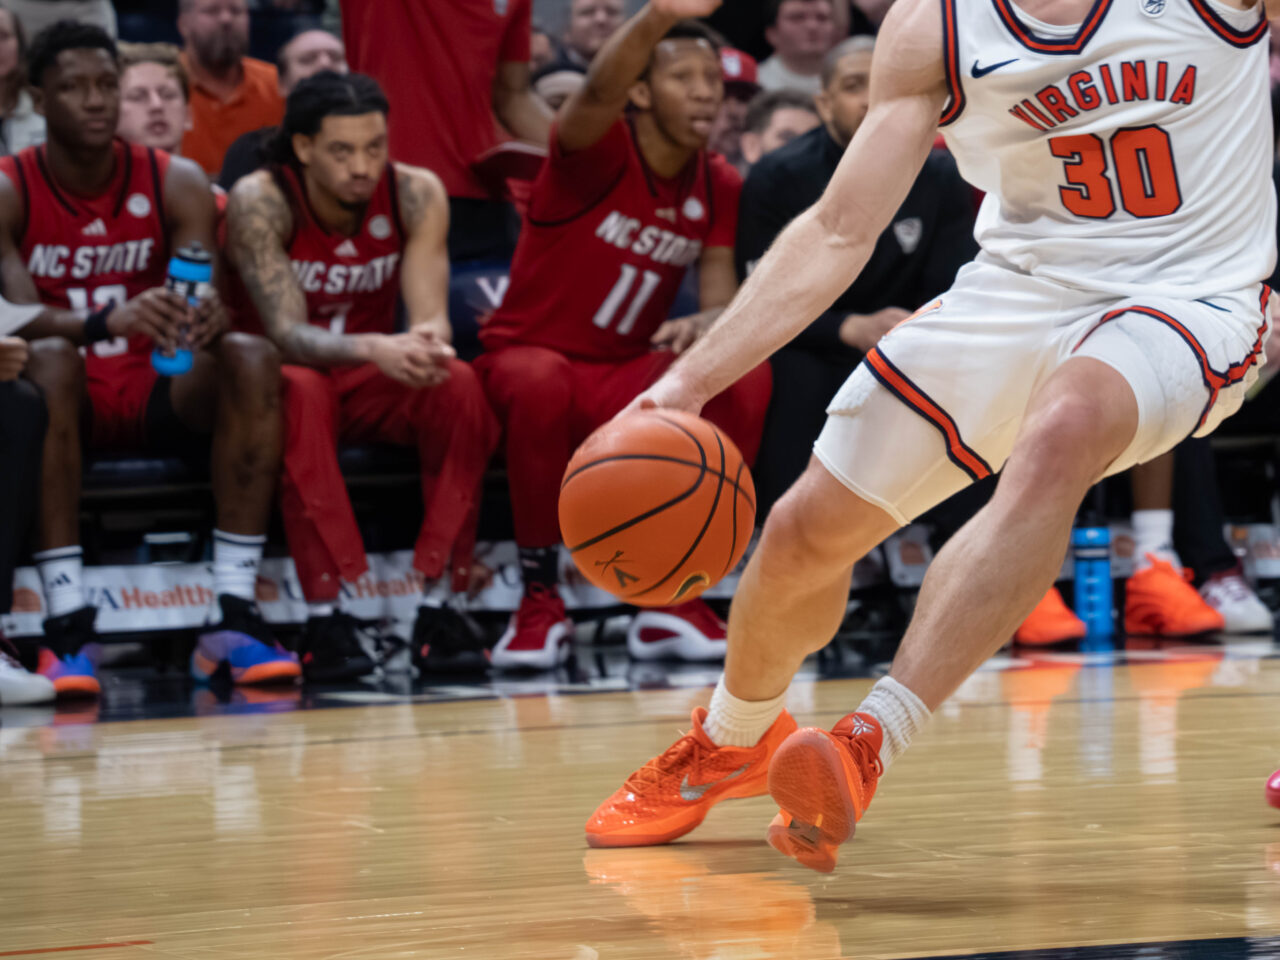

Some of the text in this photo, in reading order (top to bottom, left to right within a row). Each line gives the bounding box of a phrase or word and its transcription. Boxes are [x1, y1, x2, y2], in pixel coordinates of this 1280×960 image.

[1008, 59, 1198, 132] VIRGINIA
[1047, 123, 1183, 220] 30
[594, 209, 642, 249] NC
[29, 237, 155, 279] NC STATE
[592, 262, 662, 335] 11
[120, 582, 213, 610] Health
